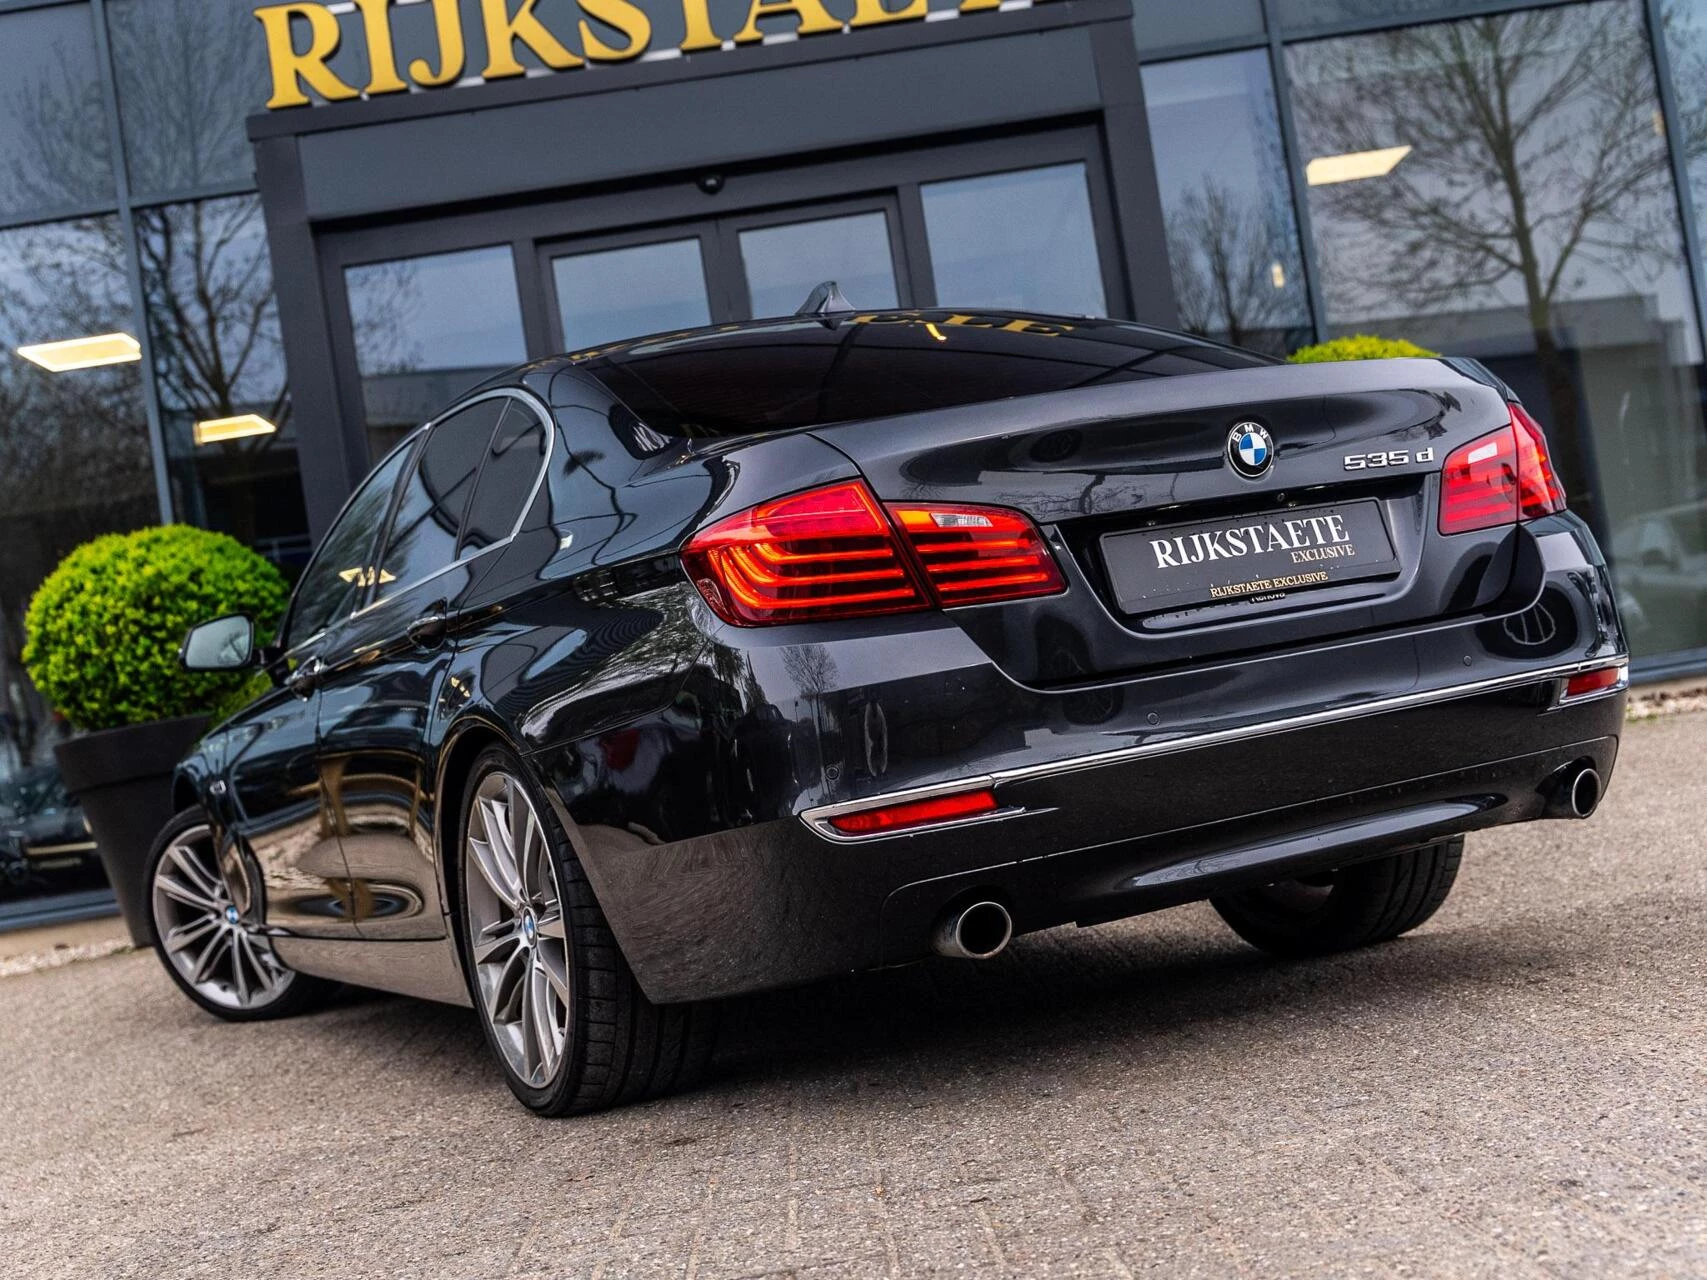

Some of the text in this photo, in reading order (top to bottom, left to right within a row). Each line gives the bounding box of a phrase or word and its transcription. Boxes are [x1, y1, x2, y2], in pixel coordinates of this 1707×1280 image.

[1232, 424, 1269, 442] BMW
[1149, 514, 1350, 569] RIJKSTAETE
[1291, 543, 1355, 564] EXCLUSIVE
[1210, 571, 1329, 598] RIJKSTAETE EXCLUSIVE
